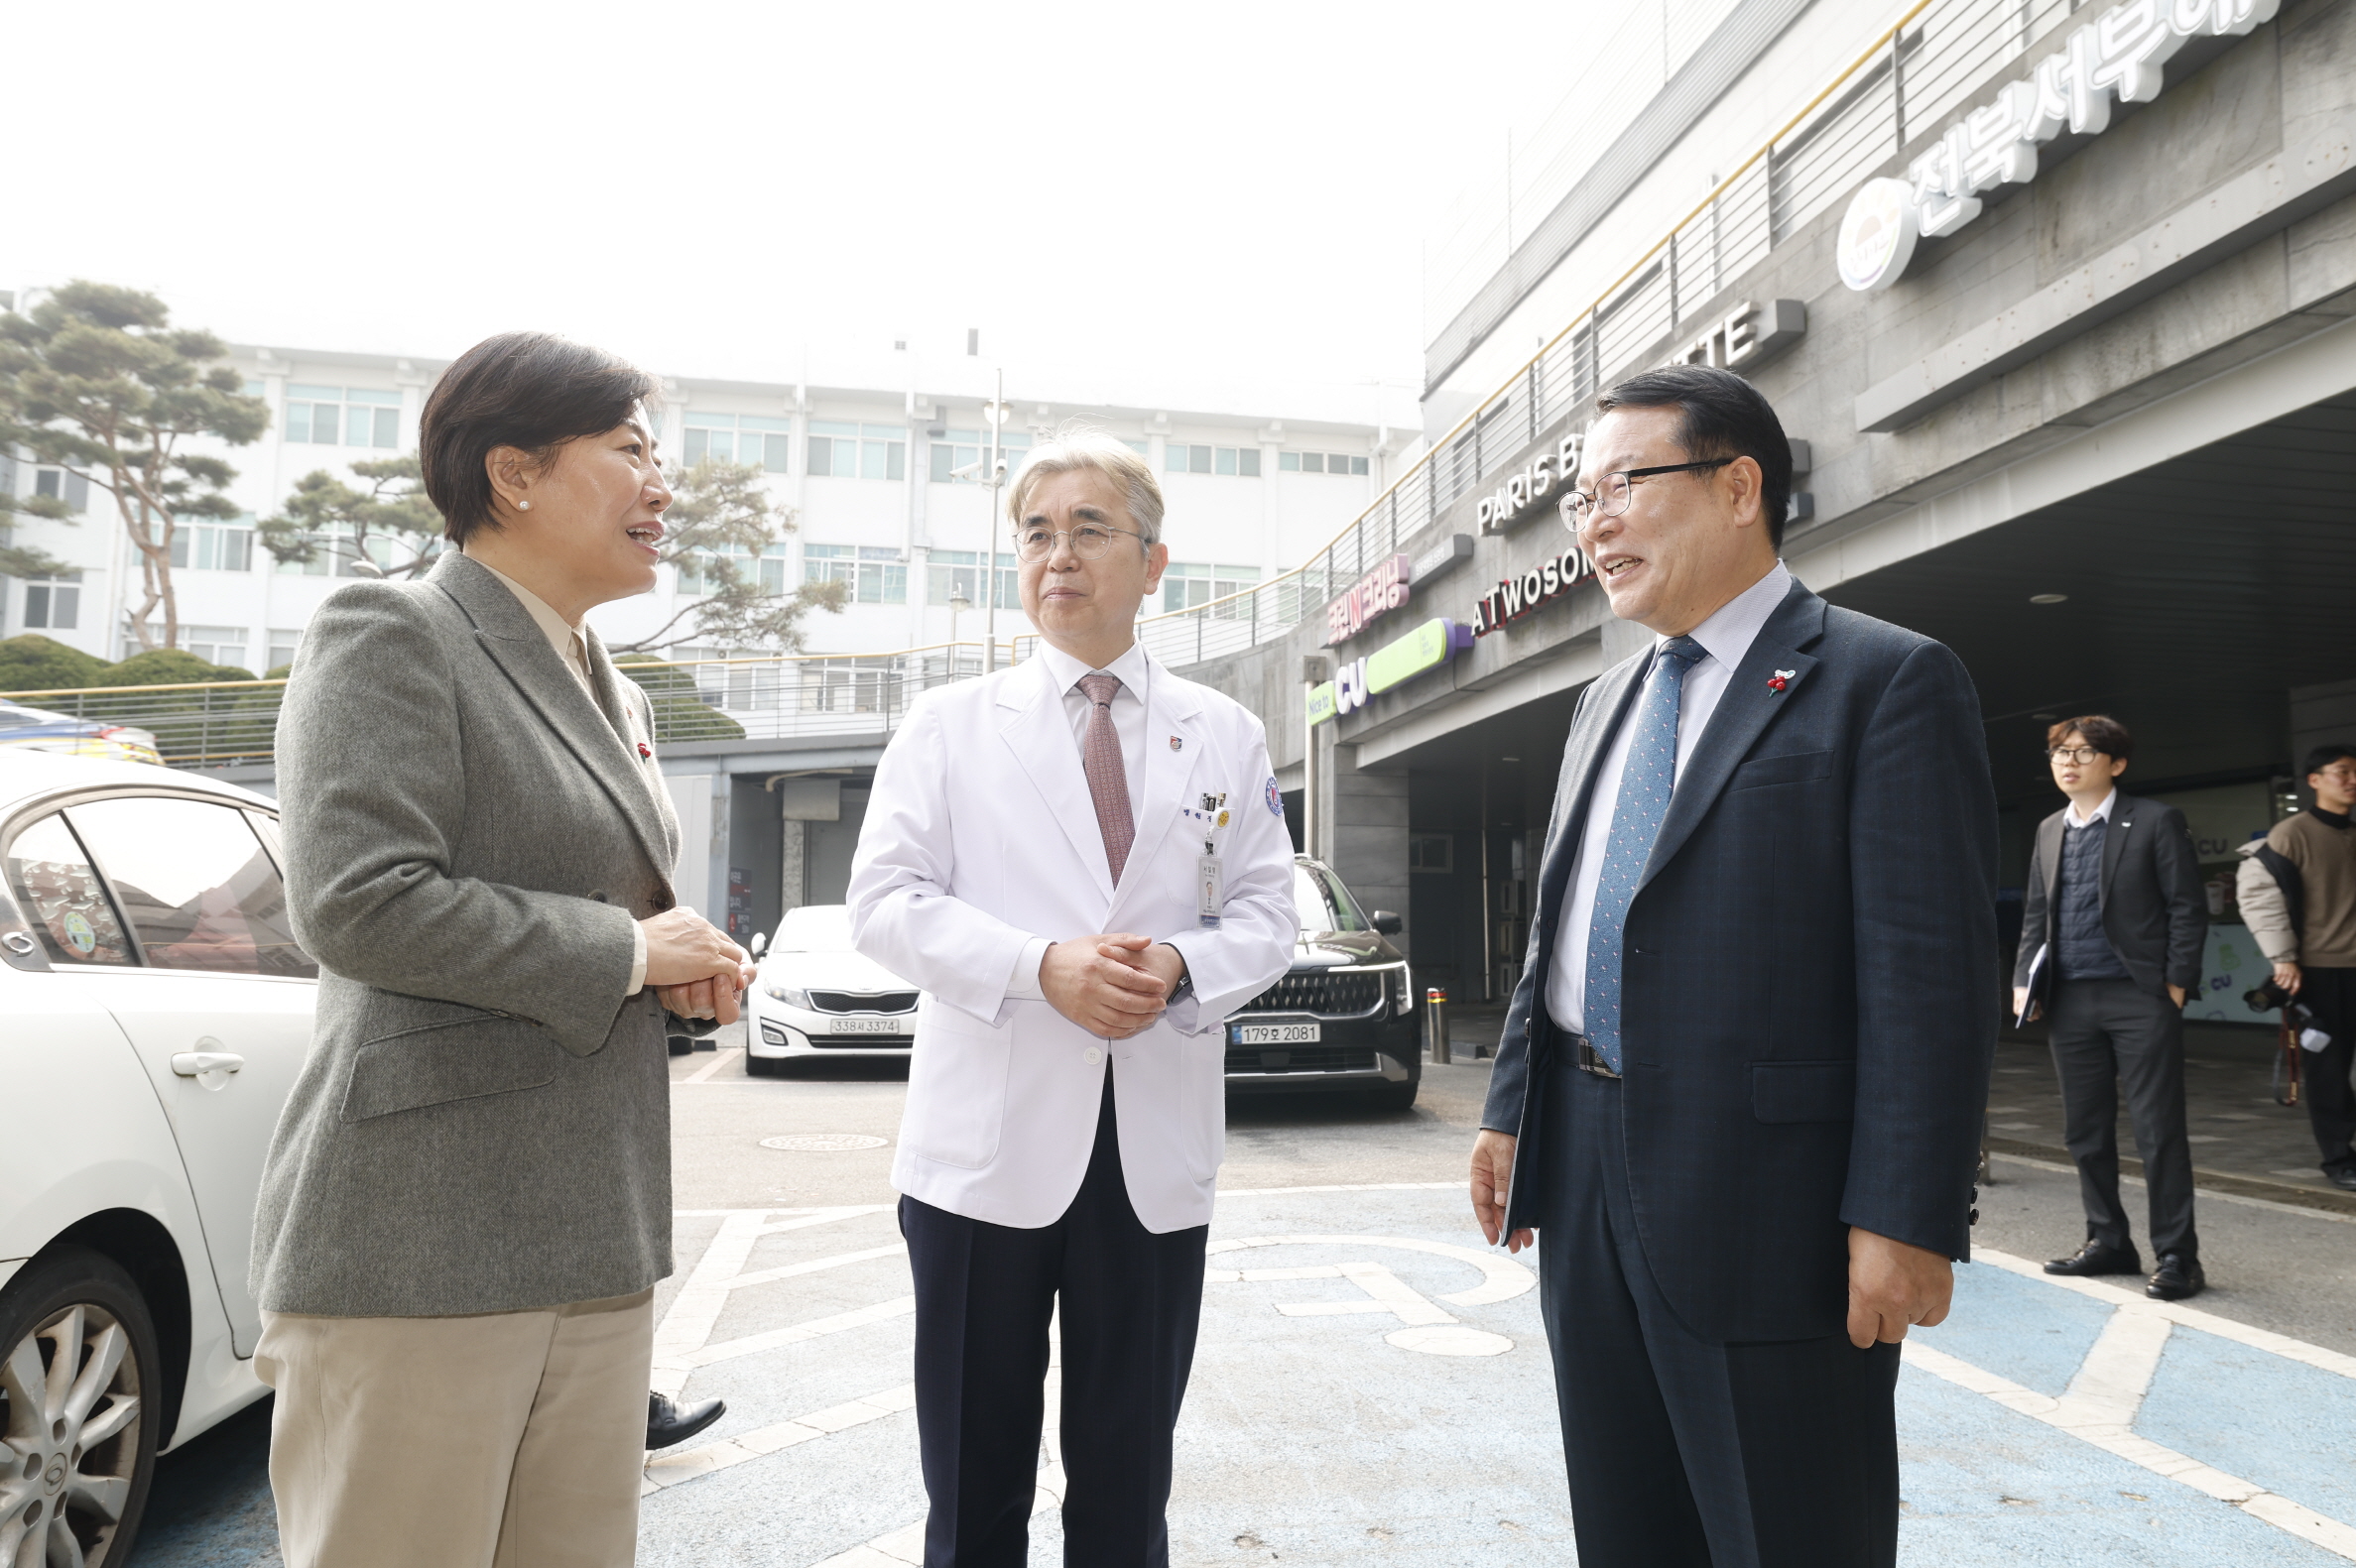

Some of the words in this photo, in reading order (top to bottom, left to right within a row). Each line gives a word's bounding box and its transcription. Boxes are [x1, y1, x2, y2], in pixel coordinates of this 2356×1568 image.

[1477, 454, 1556, 537] PARIS
[1308, 698, 1322, 716] Nice
[1335, 657, 1367, 715] CU
[2197, 839, 2228, 855] CU
[2211, 975, 2232, 990] CU
[834, 1021, 864, 1032] 338서
[866, 1021, 895, 1032] 3374
[1244, 1027, 1280, 1041] 179호
[1284, 1026, 1316, 1040] 2081
